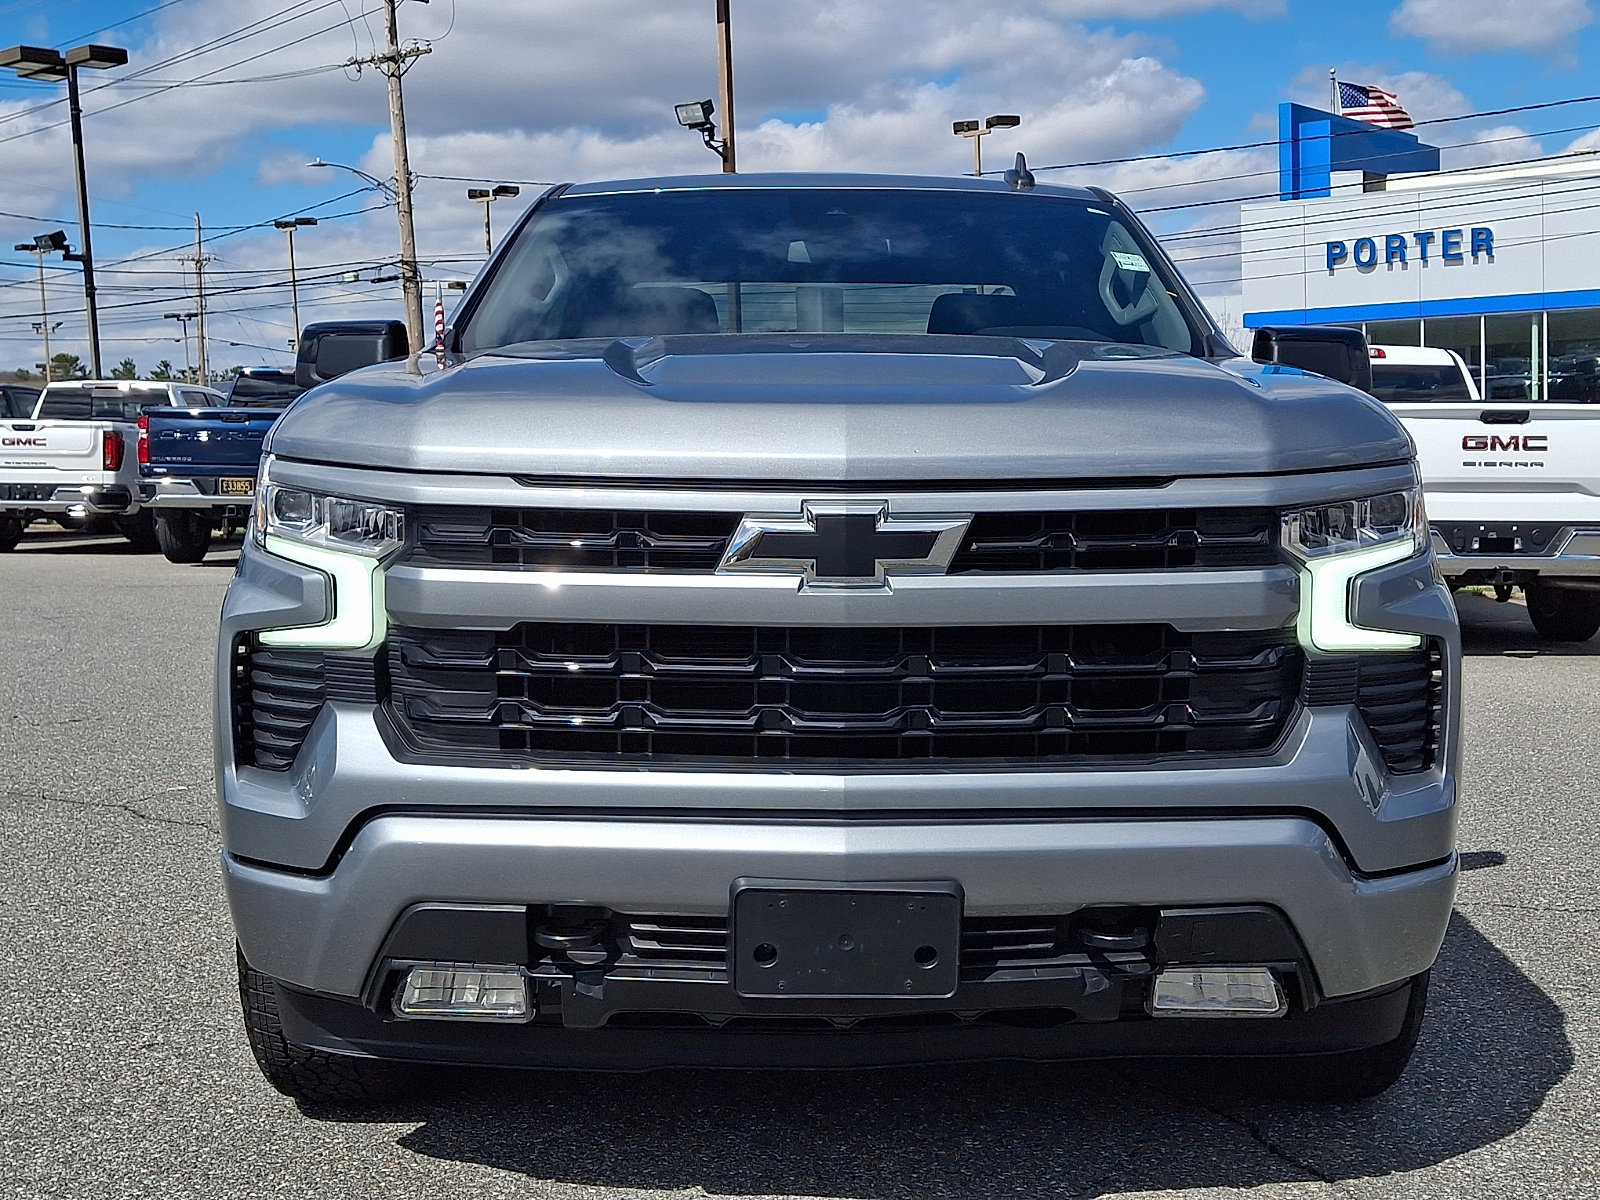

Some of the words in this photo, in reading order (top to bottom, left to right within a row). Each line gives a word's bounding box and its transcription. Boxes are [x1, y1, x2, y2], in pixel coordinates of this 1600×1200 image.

[1326, 227, 1494, 270] PORTER
[1, 438, 47, 447] GMC
[1462, 435, 1548, 451] GMC
